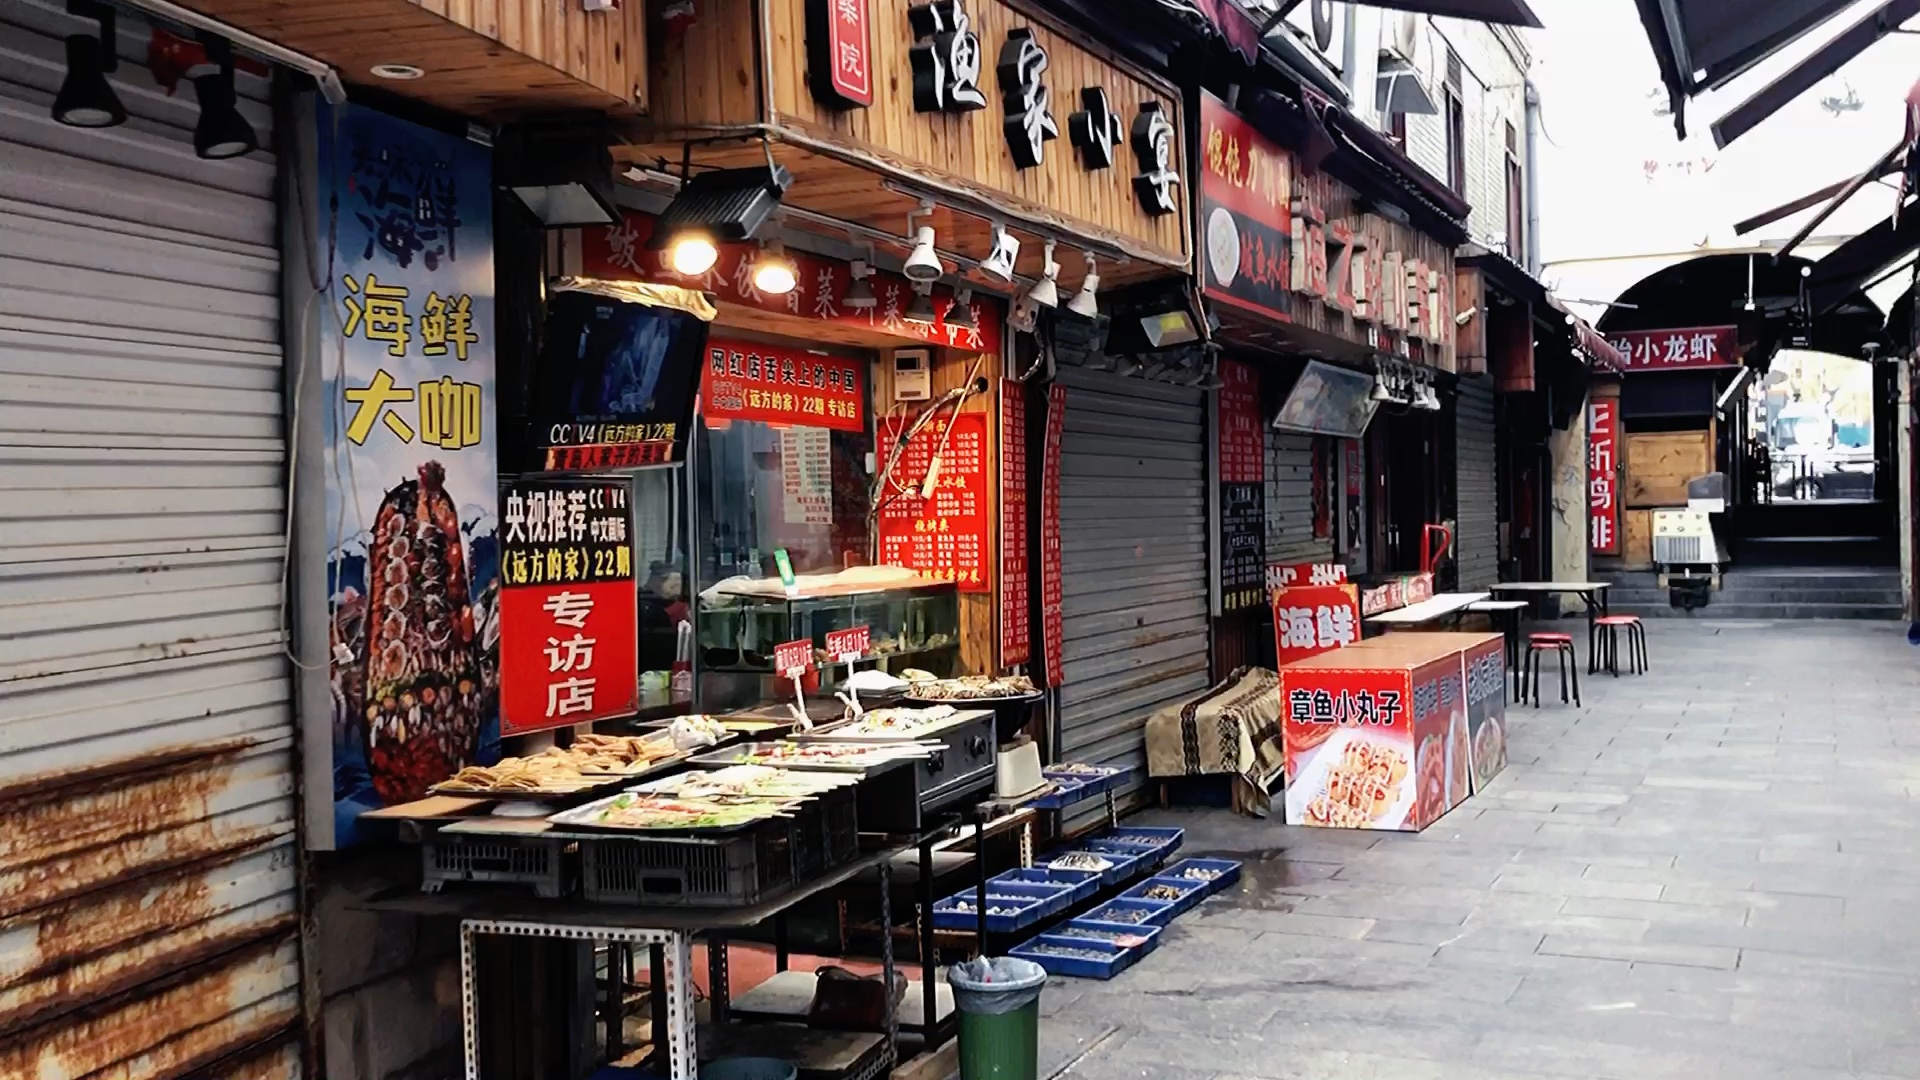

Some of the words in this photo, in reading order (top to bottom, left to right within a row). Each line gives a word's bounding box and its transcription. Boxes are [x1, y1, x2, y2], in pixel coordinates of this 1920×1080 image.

[342, 273, 480, 361] 海鲜
[710, 347, 856, 404] 网红店舌尖上的中国
[344, 368, 483, 451] 大咖
[504, 489, 588, 545] 央视推荐
[542, 591, 597, 718] 专访店
[1279, 604, 1355, 649] 海鲜
[1290, 688, 1402, 727] 章鱼小丸子
